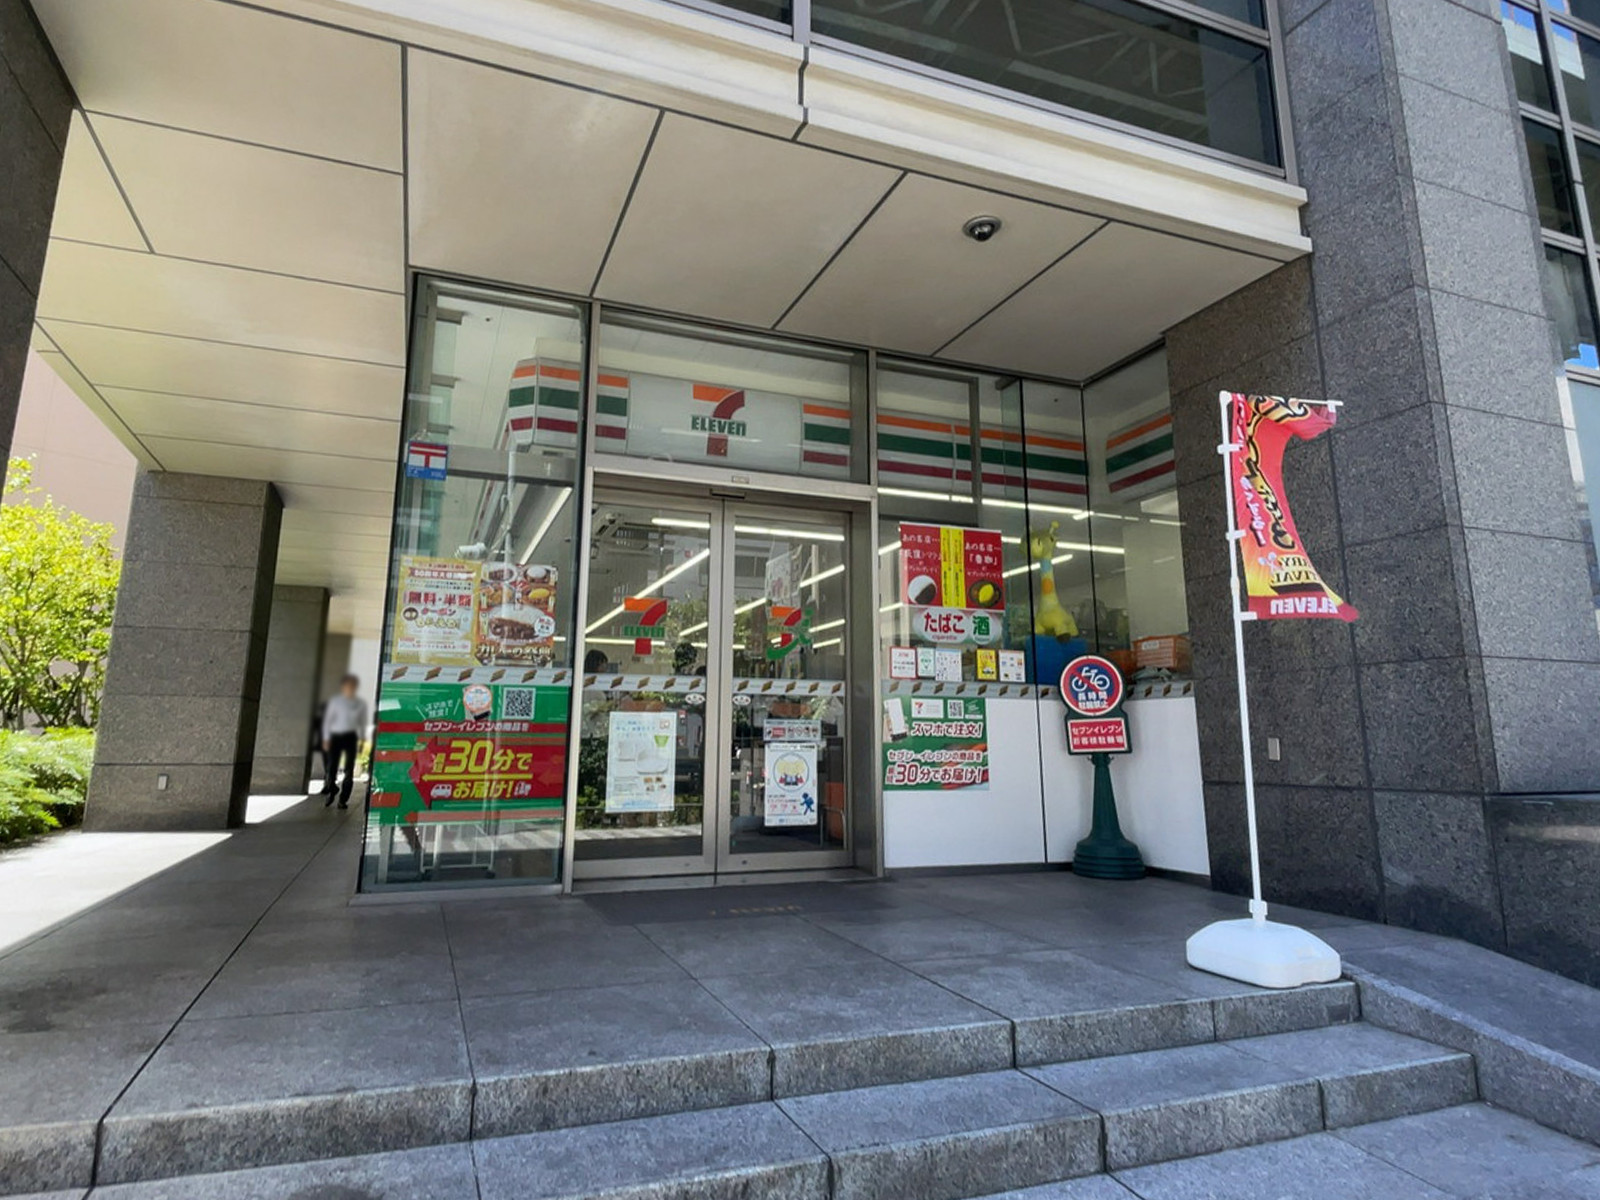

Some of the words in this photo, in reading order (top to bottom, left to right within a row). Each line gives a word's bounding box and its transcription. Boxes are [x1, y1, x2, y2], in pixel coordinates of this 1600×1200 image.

[924, 612, 965, 633] たばこ
[972, 615, 990, 636] 酒
[1072, 725, 1122, 735] セブンイレブン
